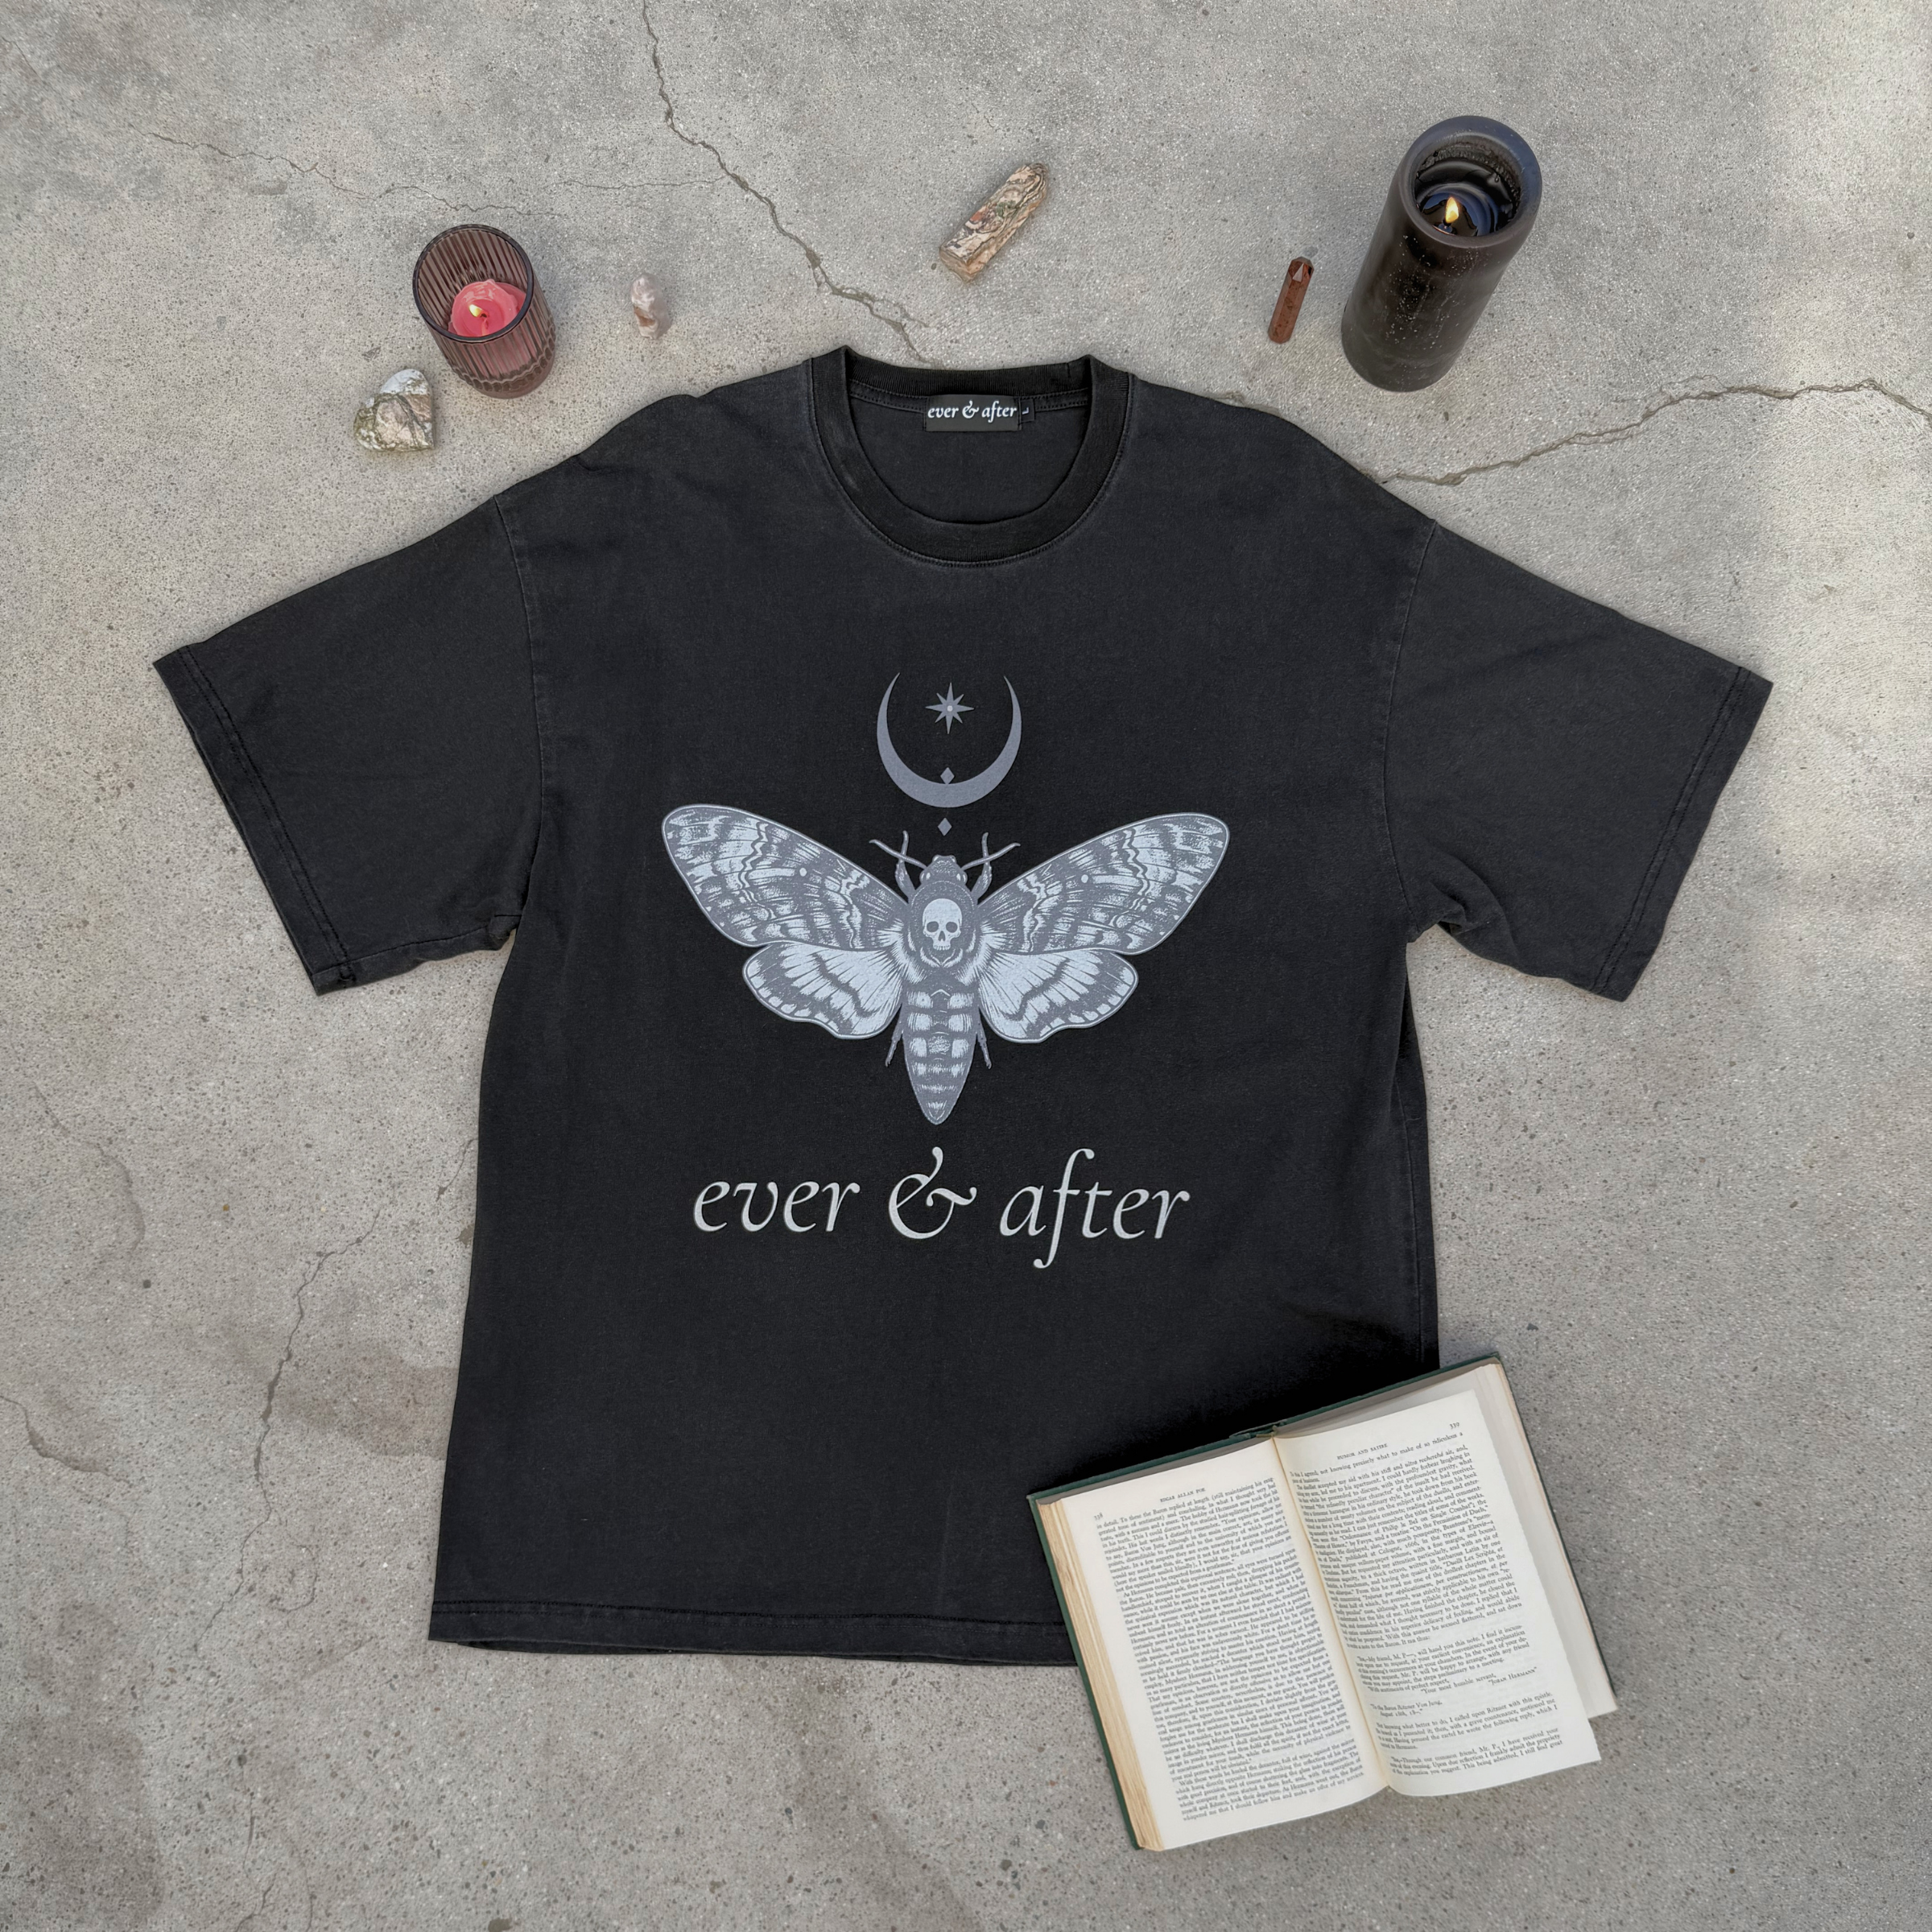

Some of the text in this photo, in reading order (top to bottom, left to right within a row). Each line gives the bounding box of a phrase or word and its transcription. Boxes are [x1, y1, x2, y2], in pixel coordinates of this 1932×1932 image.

[928, 400, 1018, 423] ever & after
[694, 1146, 1191, 1269] ever & after
[1459, 1458, 1472, 1466] what
[1386, 1472, 1402, 1480] could
[1402, 1468, 1419, 1476] hardly
[1463, 1472, 1477, 1480] book
[1381, 1525, 1398, 1533] Philip
